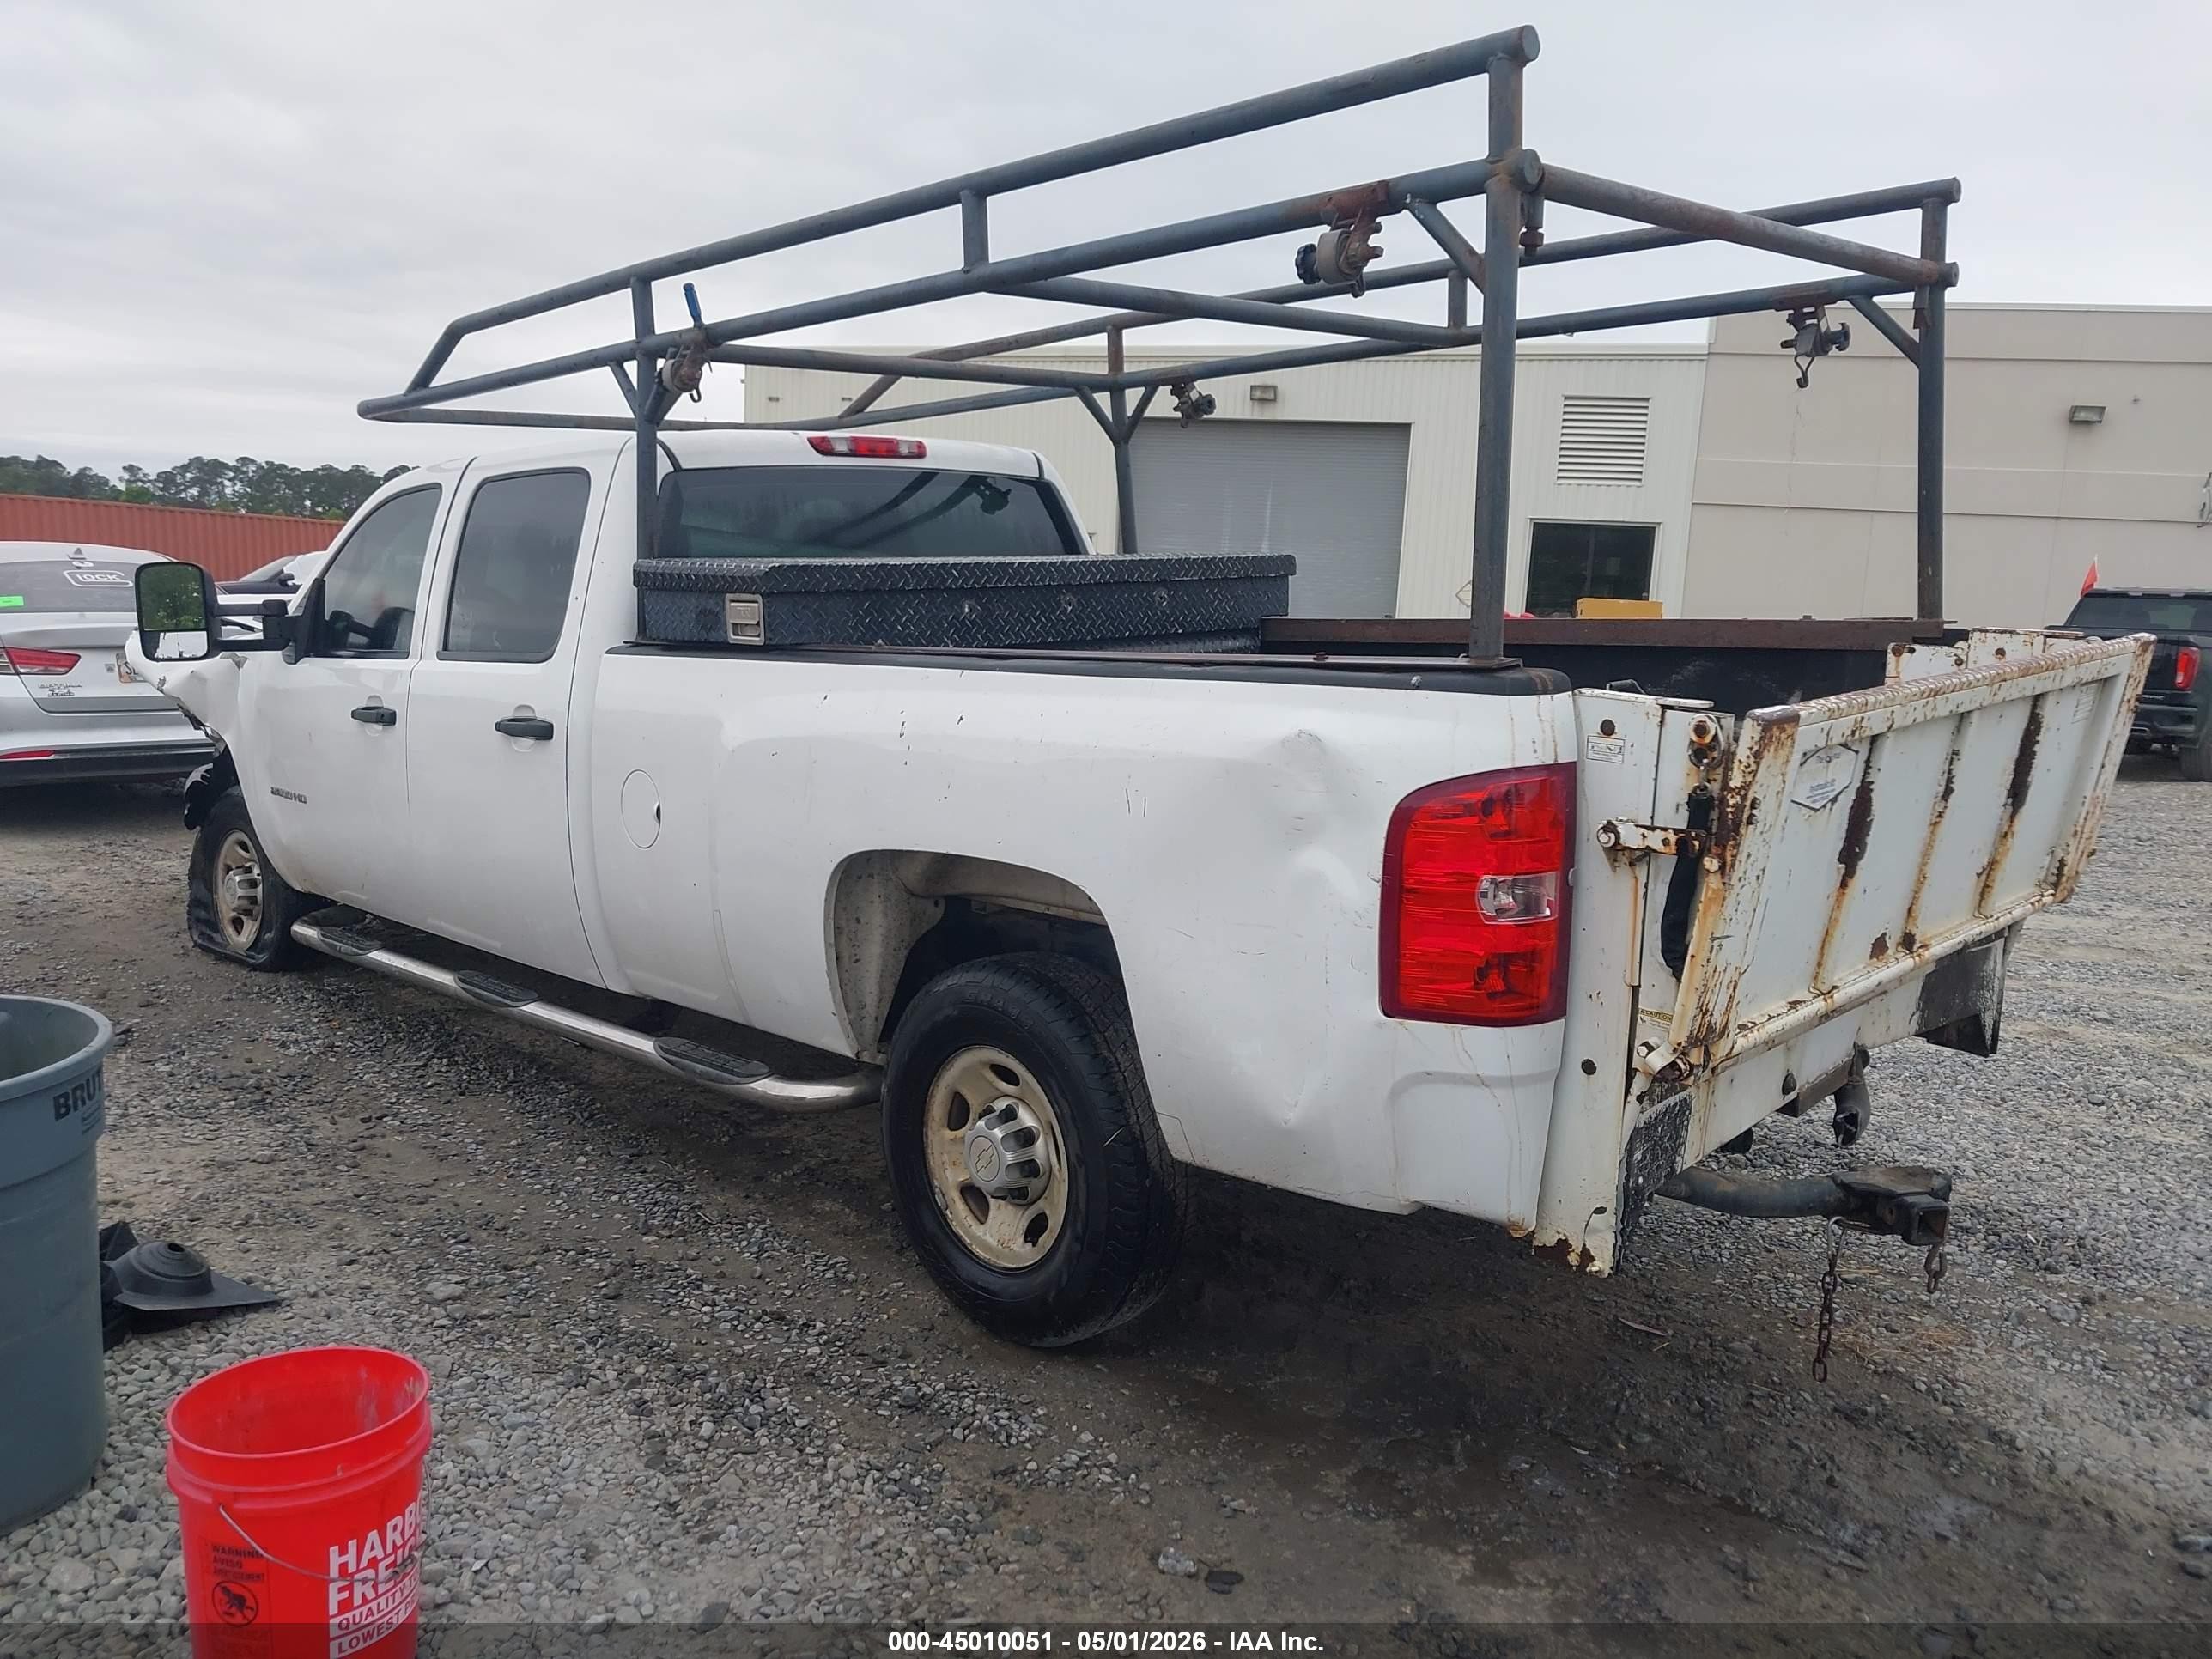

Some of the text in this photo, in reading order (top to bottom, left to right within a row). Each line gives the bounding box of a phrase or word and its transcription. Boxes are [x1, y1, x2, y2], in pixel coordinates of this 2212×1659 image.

[330, 1502, 420, 1578] HARB
[337, 1584, 406, 1632] QUALITY
[337, 1611, 404, 1655] LOWEST
